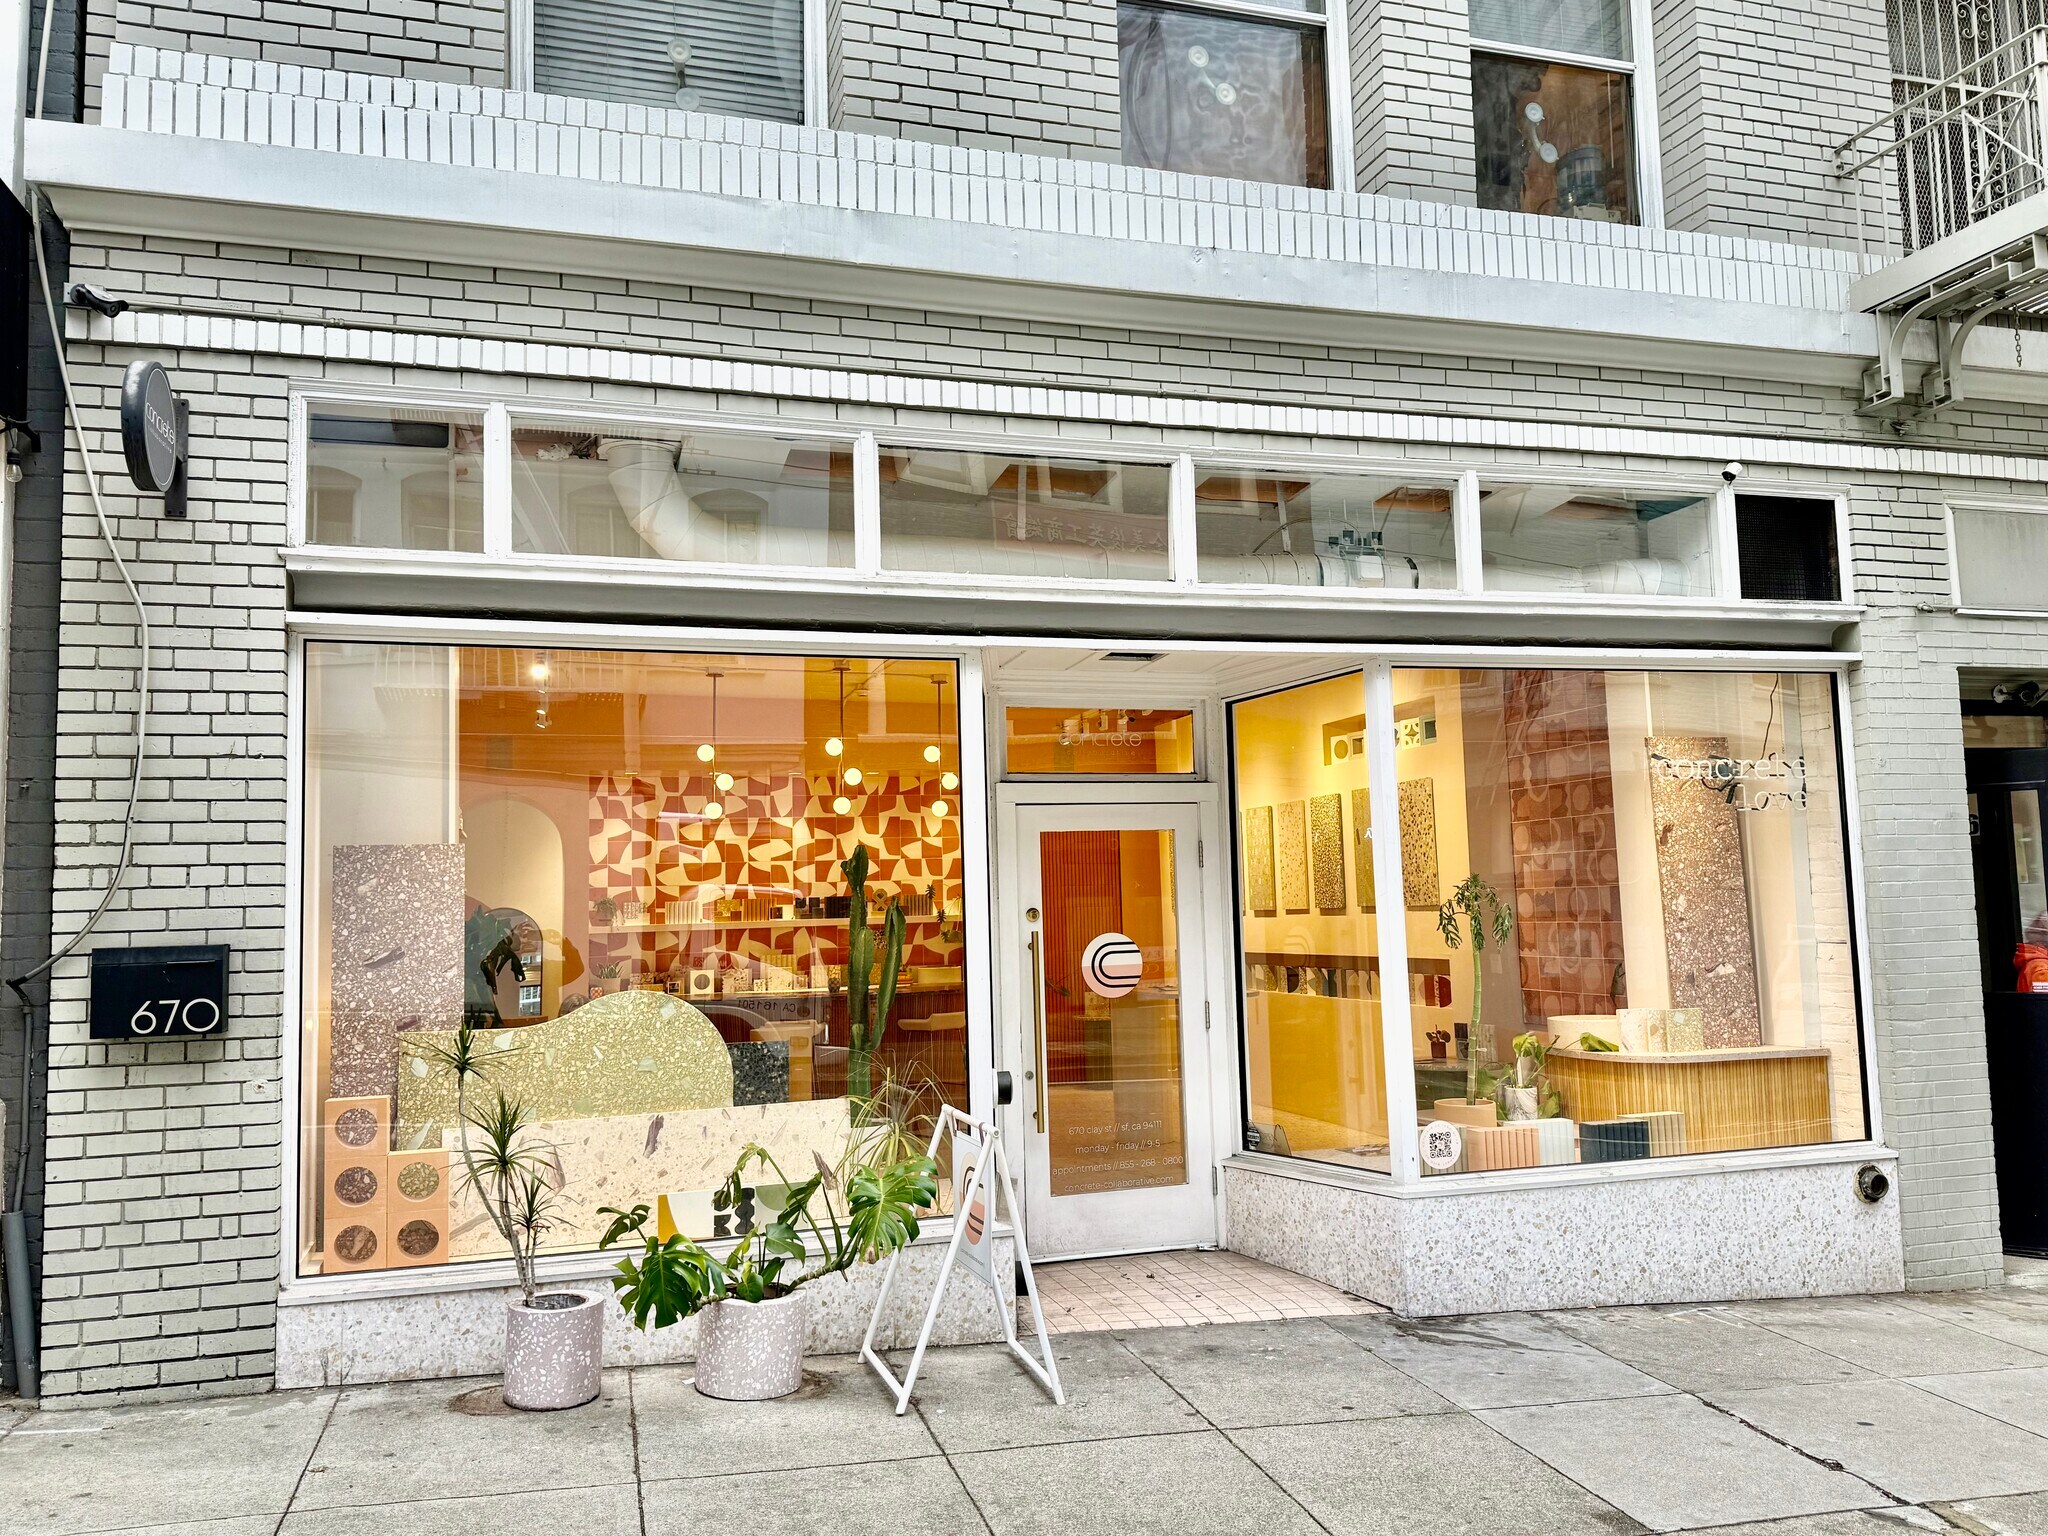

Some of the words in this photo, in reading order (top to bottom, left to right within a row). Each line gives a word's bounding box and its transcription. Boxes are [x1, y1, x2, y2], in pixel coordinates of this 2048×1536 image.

[1059, 730, 1142, 747] concrete
[1656, 753, 1807, 780] concrete
[1735, 784, 1808, 812] love
[131, 998, 220, 1034] 670
[1068, 1126, 1085, 1136] 670
[1086, 1125, 1103, 1135] clay
[1104, 1124, 1113, 1133] st
[1131, 1123, 1142, 1131] ca
[1142, 1120, 1162, 1130] 94111
[1075, 1143, 1110, 1154] monday
[1116, 1141, 1140, 1151] friday
[1052, 1162, 1112, 1176] appointments
[1064, 1175, 1174, 1192] concrete-collaborative.com
